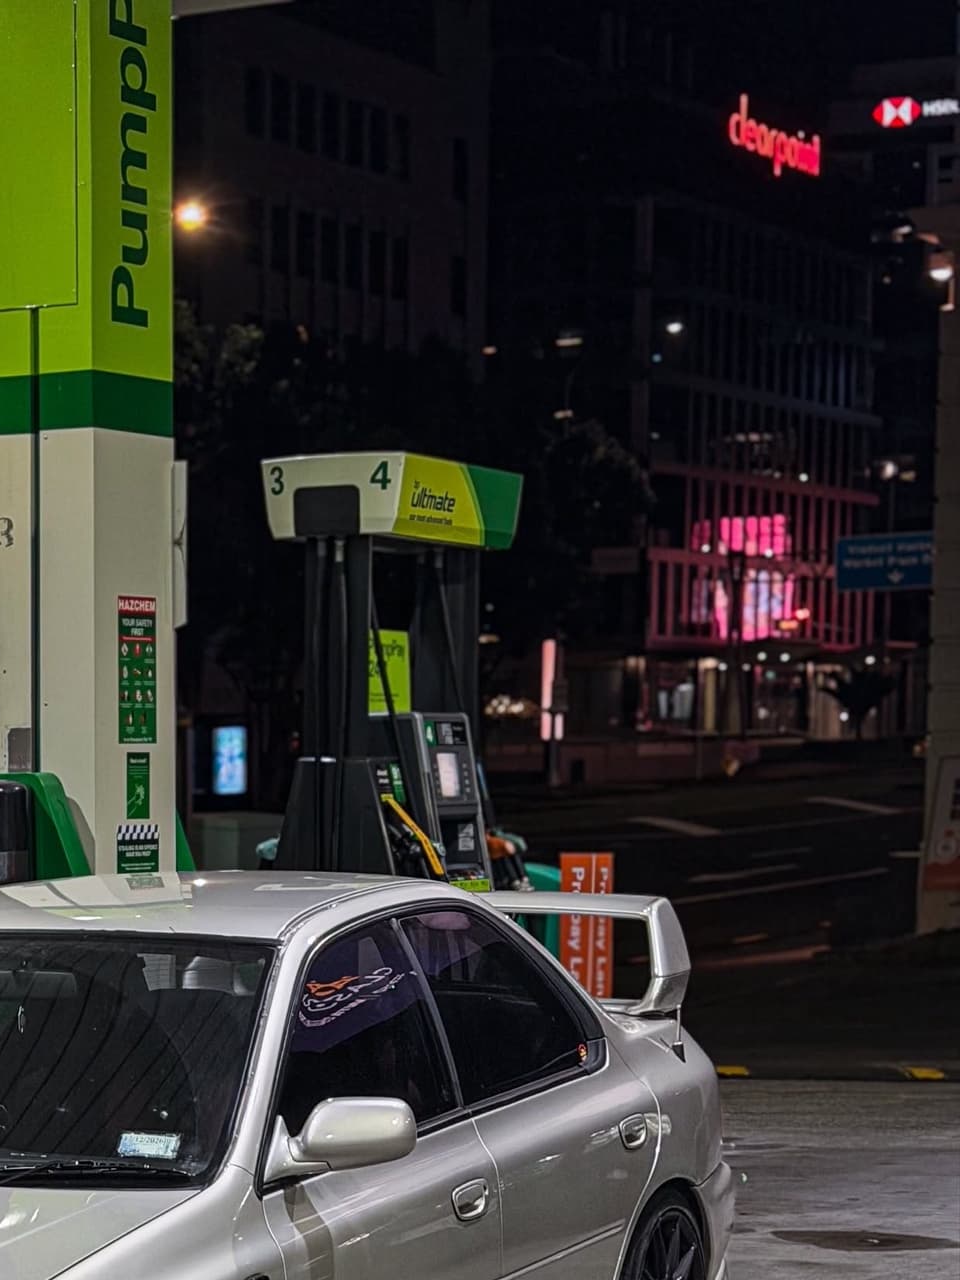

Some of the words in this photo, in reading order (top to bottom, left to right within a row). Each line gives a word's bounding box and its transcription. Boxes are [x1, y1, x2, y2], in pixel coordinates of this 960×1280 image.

[270, 466, 284, 496] 3
[370, 460, 391, 490] 4
[411, 486, 455, 513] ultimate
[118, 599, 156, 612] HAZCHEM
[121, 617, 136, 627] YOUR
